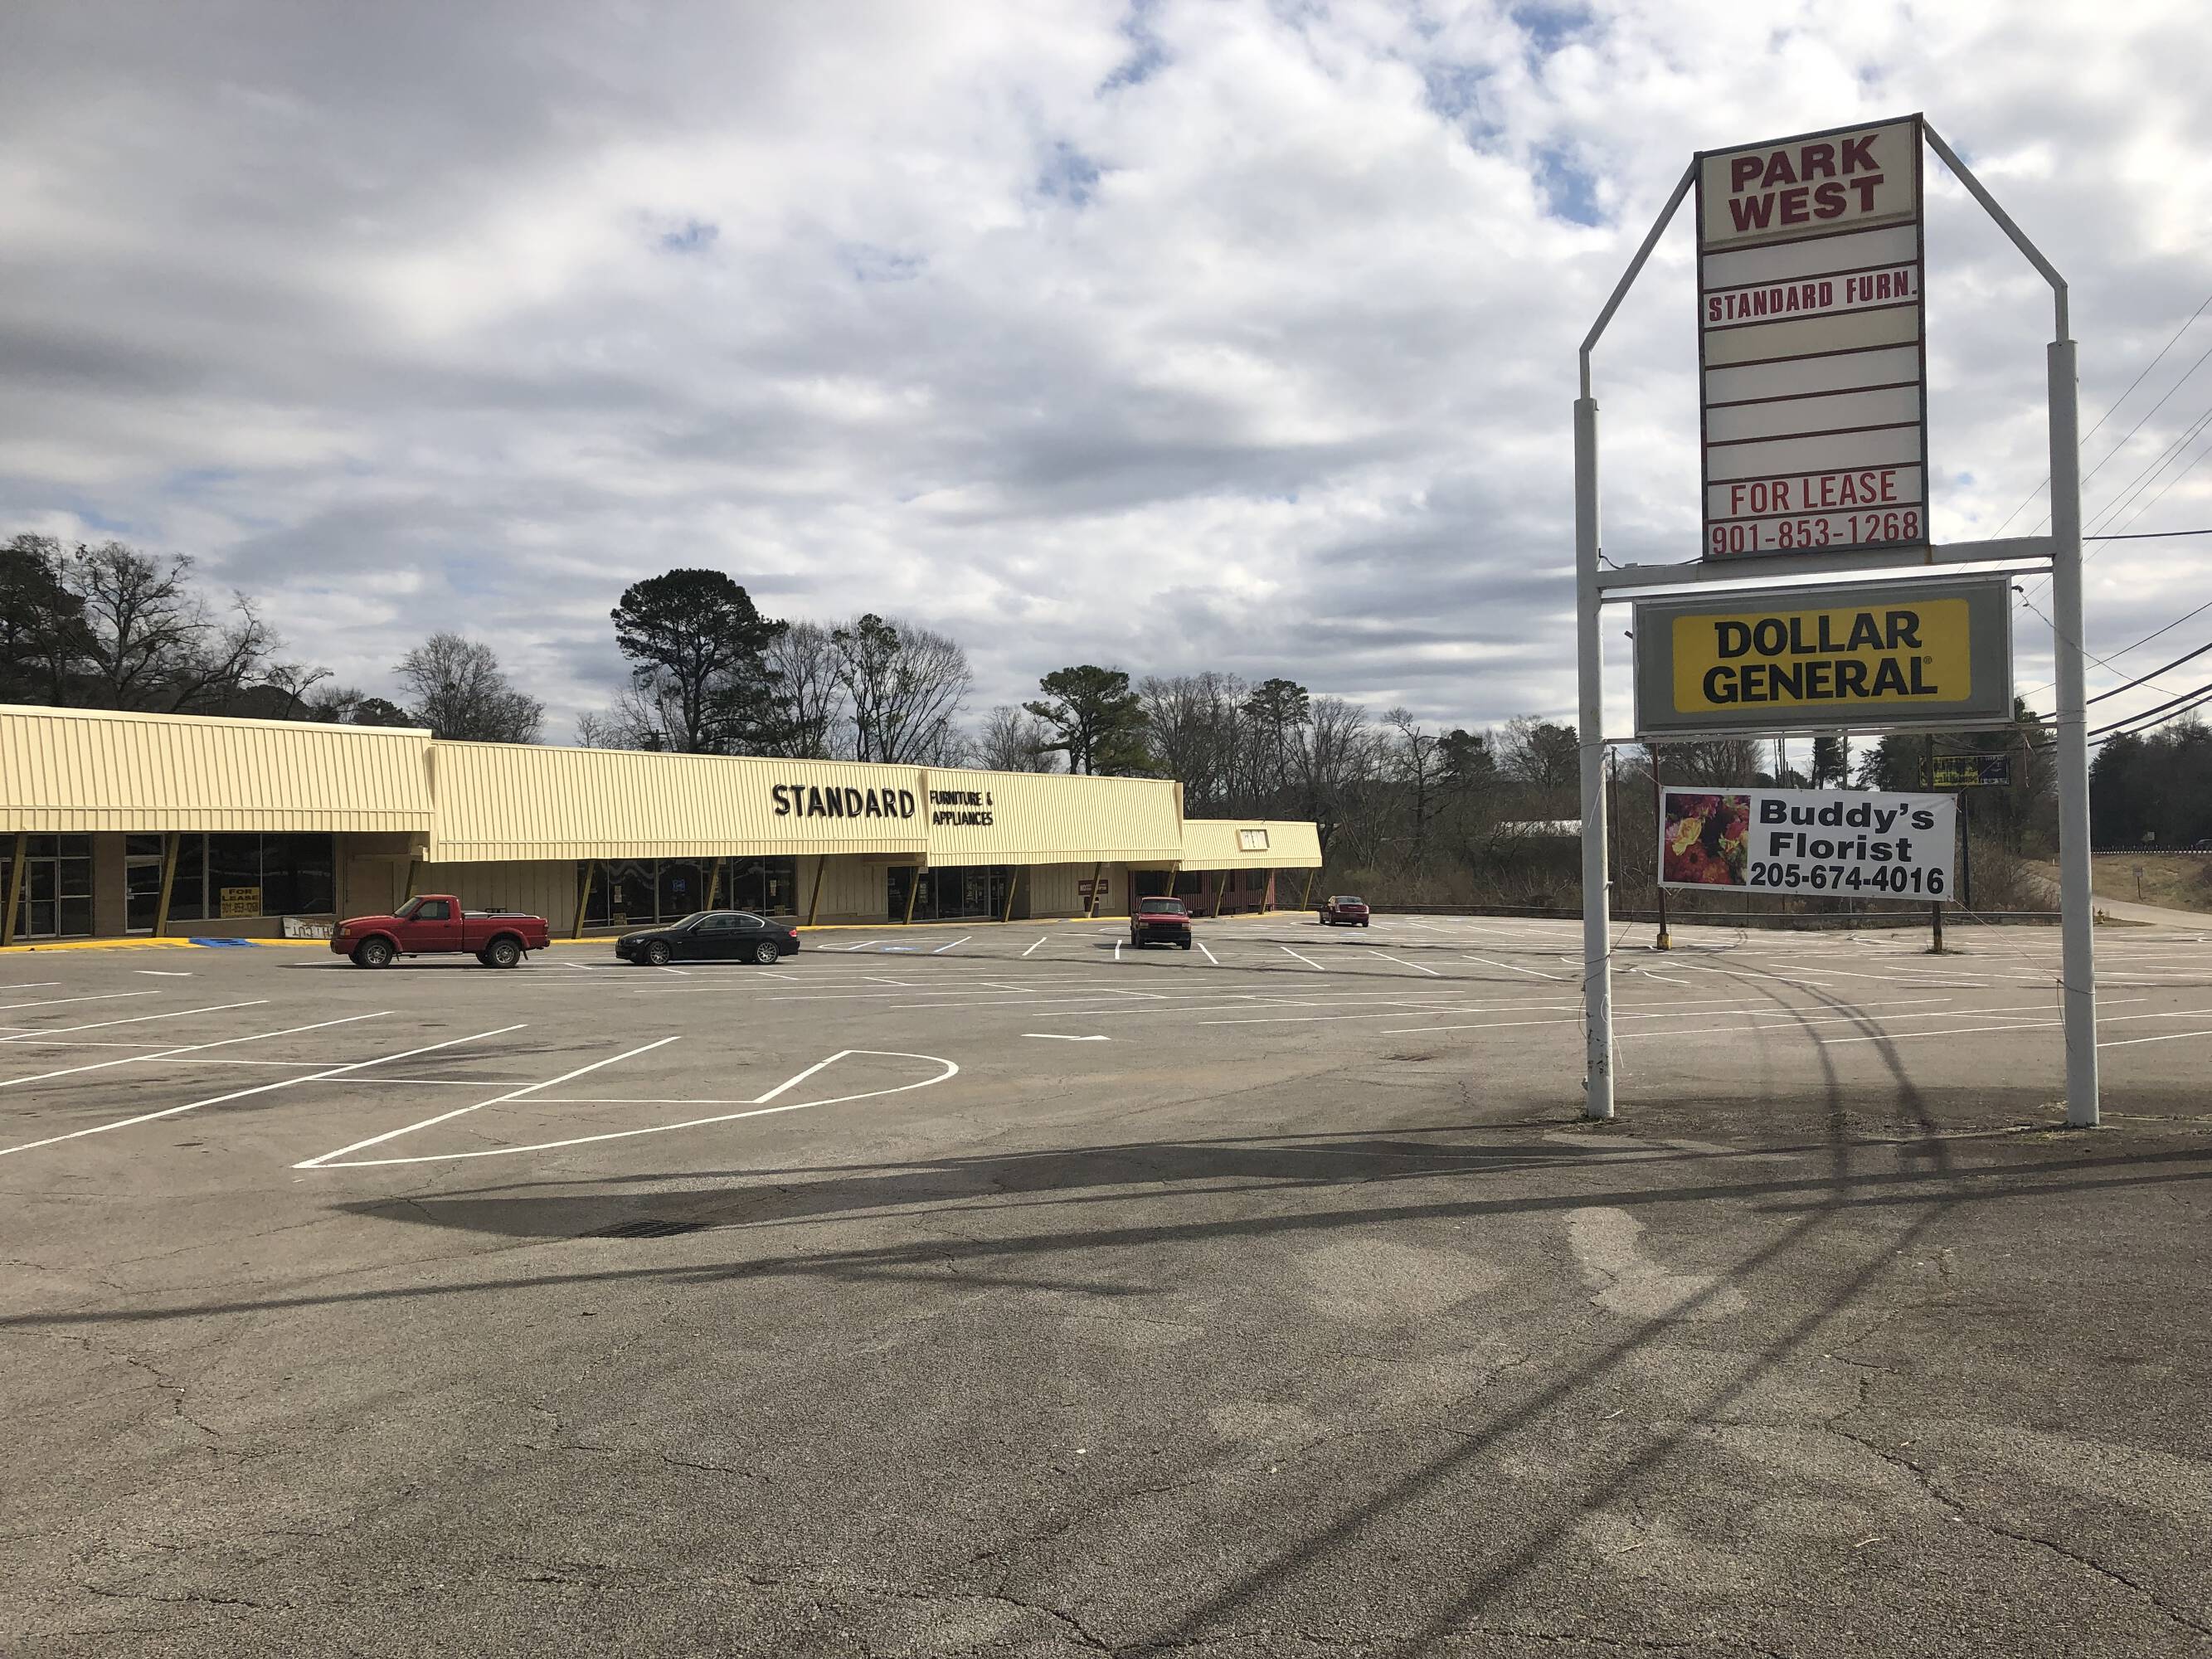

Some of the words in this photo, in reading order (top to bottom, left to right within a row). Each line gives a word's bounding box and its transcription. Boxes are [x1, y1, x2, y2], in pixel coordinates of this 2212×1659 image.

[1731, 134, 1880, 193] PARK
[1728, 173, 1884, 232] WEST
[1709, 281, 1833, 322] STANDARD
[1846, 270, 1917, 304] FURN.
[1731, 481, 1790, 515] FOR
[1803, 470, 1898, 508] LEASE
[1712, 511, 1918, 554] 901-853-1268
[1714, 611, 1922, 659] DOLLAR
[772, 784, 915, 819] STANDARD
[930, 790, 982, 805] FURNITURE
[986, 791, 993, 805] &
[1759, 799, 1935, 834] Buddy's
[932, 811, 994, 825] APPLIANCES
[1769, 832, 1913, 862] Florist
[1750, 862, 1945, 894] 205-674-4016
